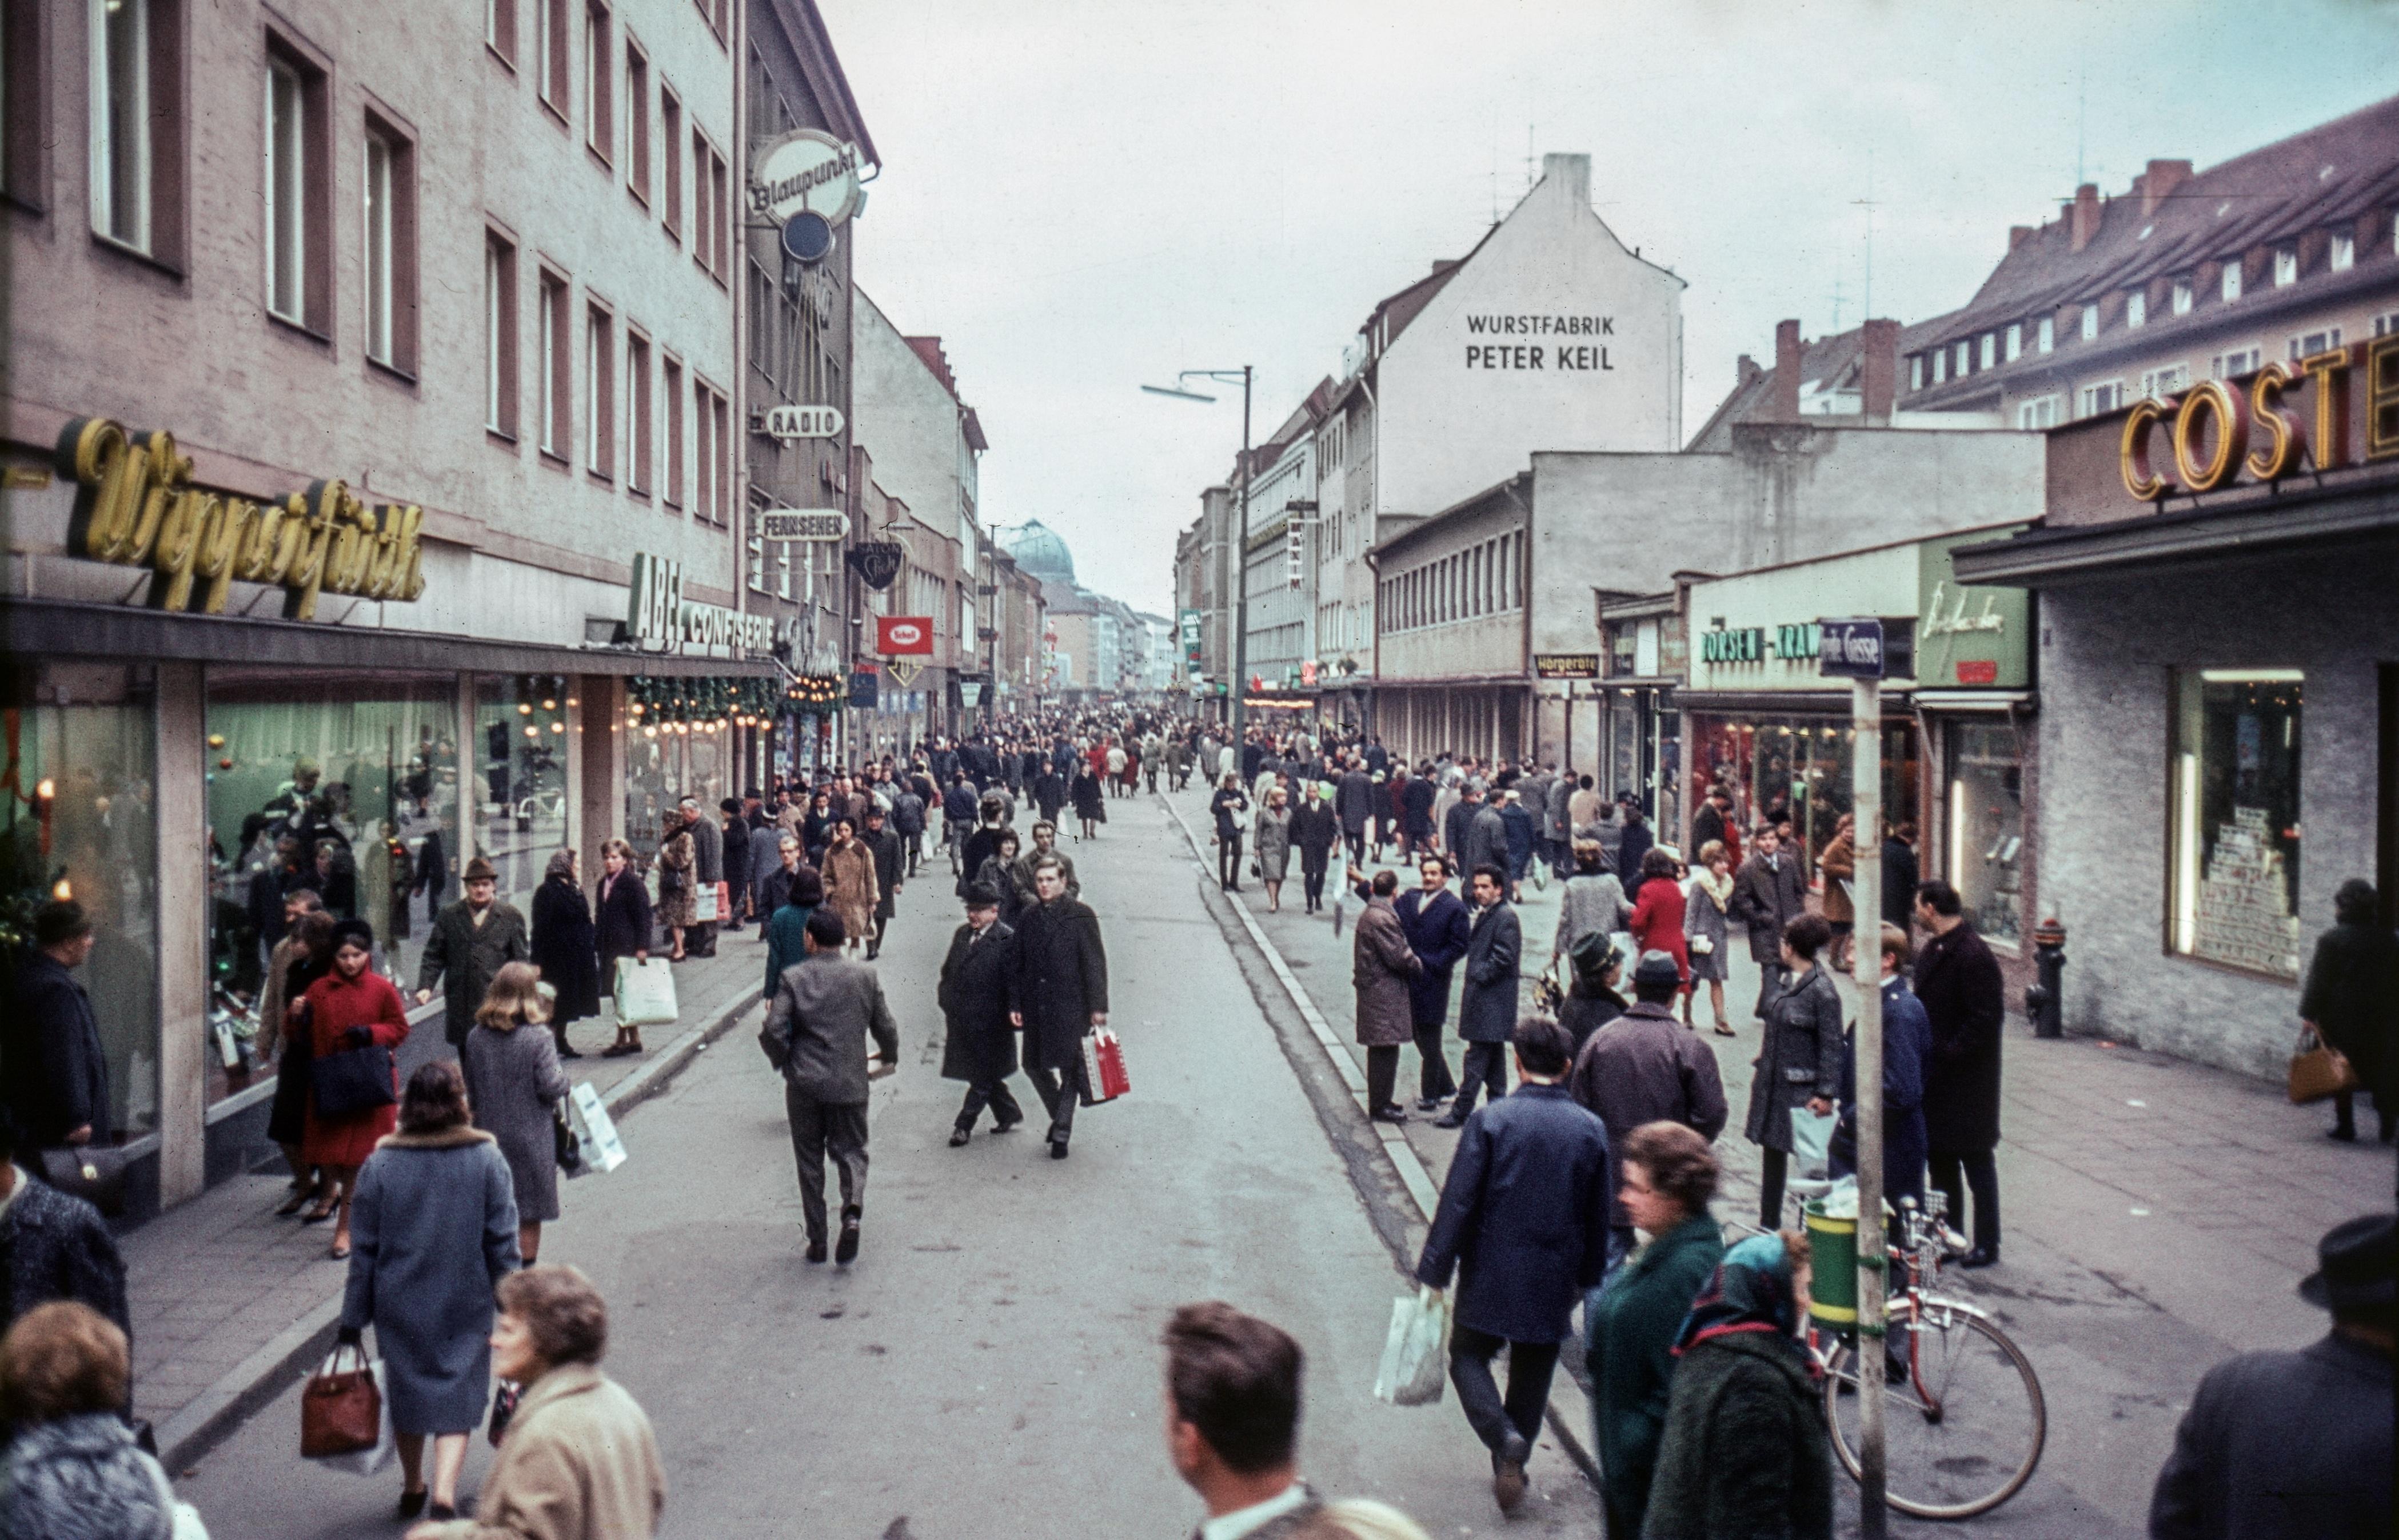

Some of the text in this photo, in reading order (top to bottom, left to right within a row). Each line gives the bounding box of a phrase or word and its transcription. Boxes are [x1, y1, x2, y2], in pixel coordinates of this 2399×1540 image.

[751, 144, 855, 211] Blaupunkt
[1467, 315, 1614, 335] WURSTFABRIK
[1466, 346, 1614, 370] PETER KEIL
[773, 411, 835, 433] RADIO
[764, 515, 843, 536] FERNSEHEN
[1289, 522, 1302, 592] MAXIM
[632, 552, 685, 639] ABEL
[688, 604, 775, 651] CONFISERIE
